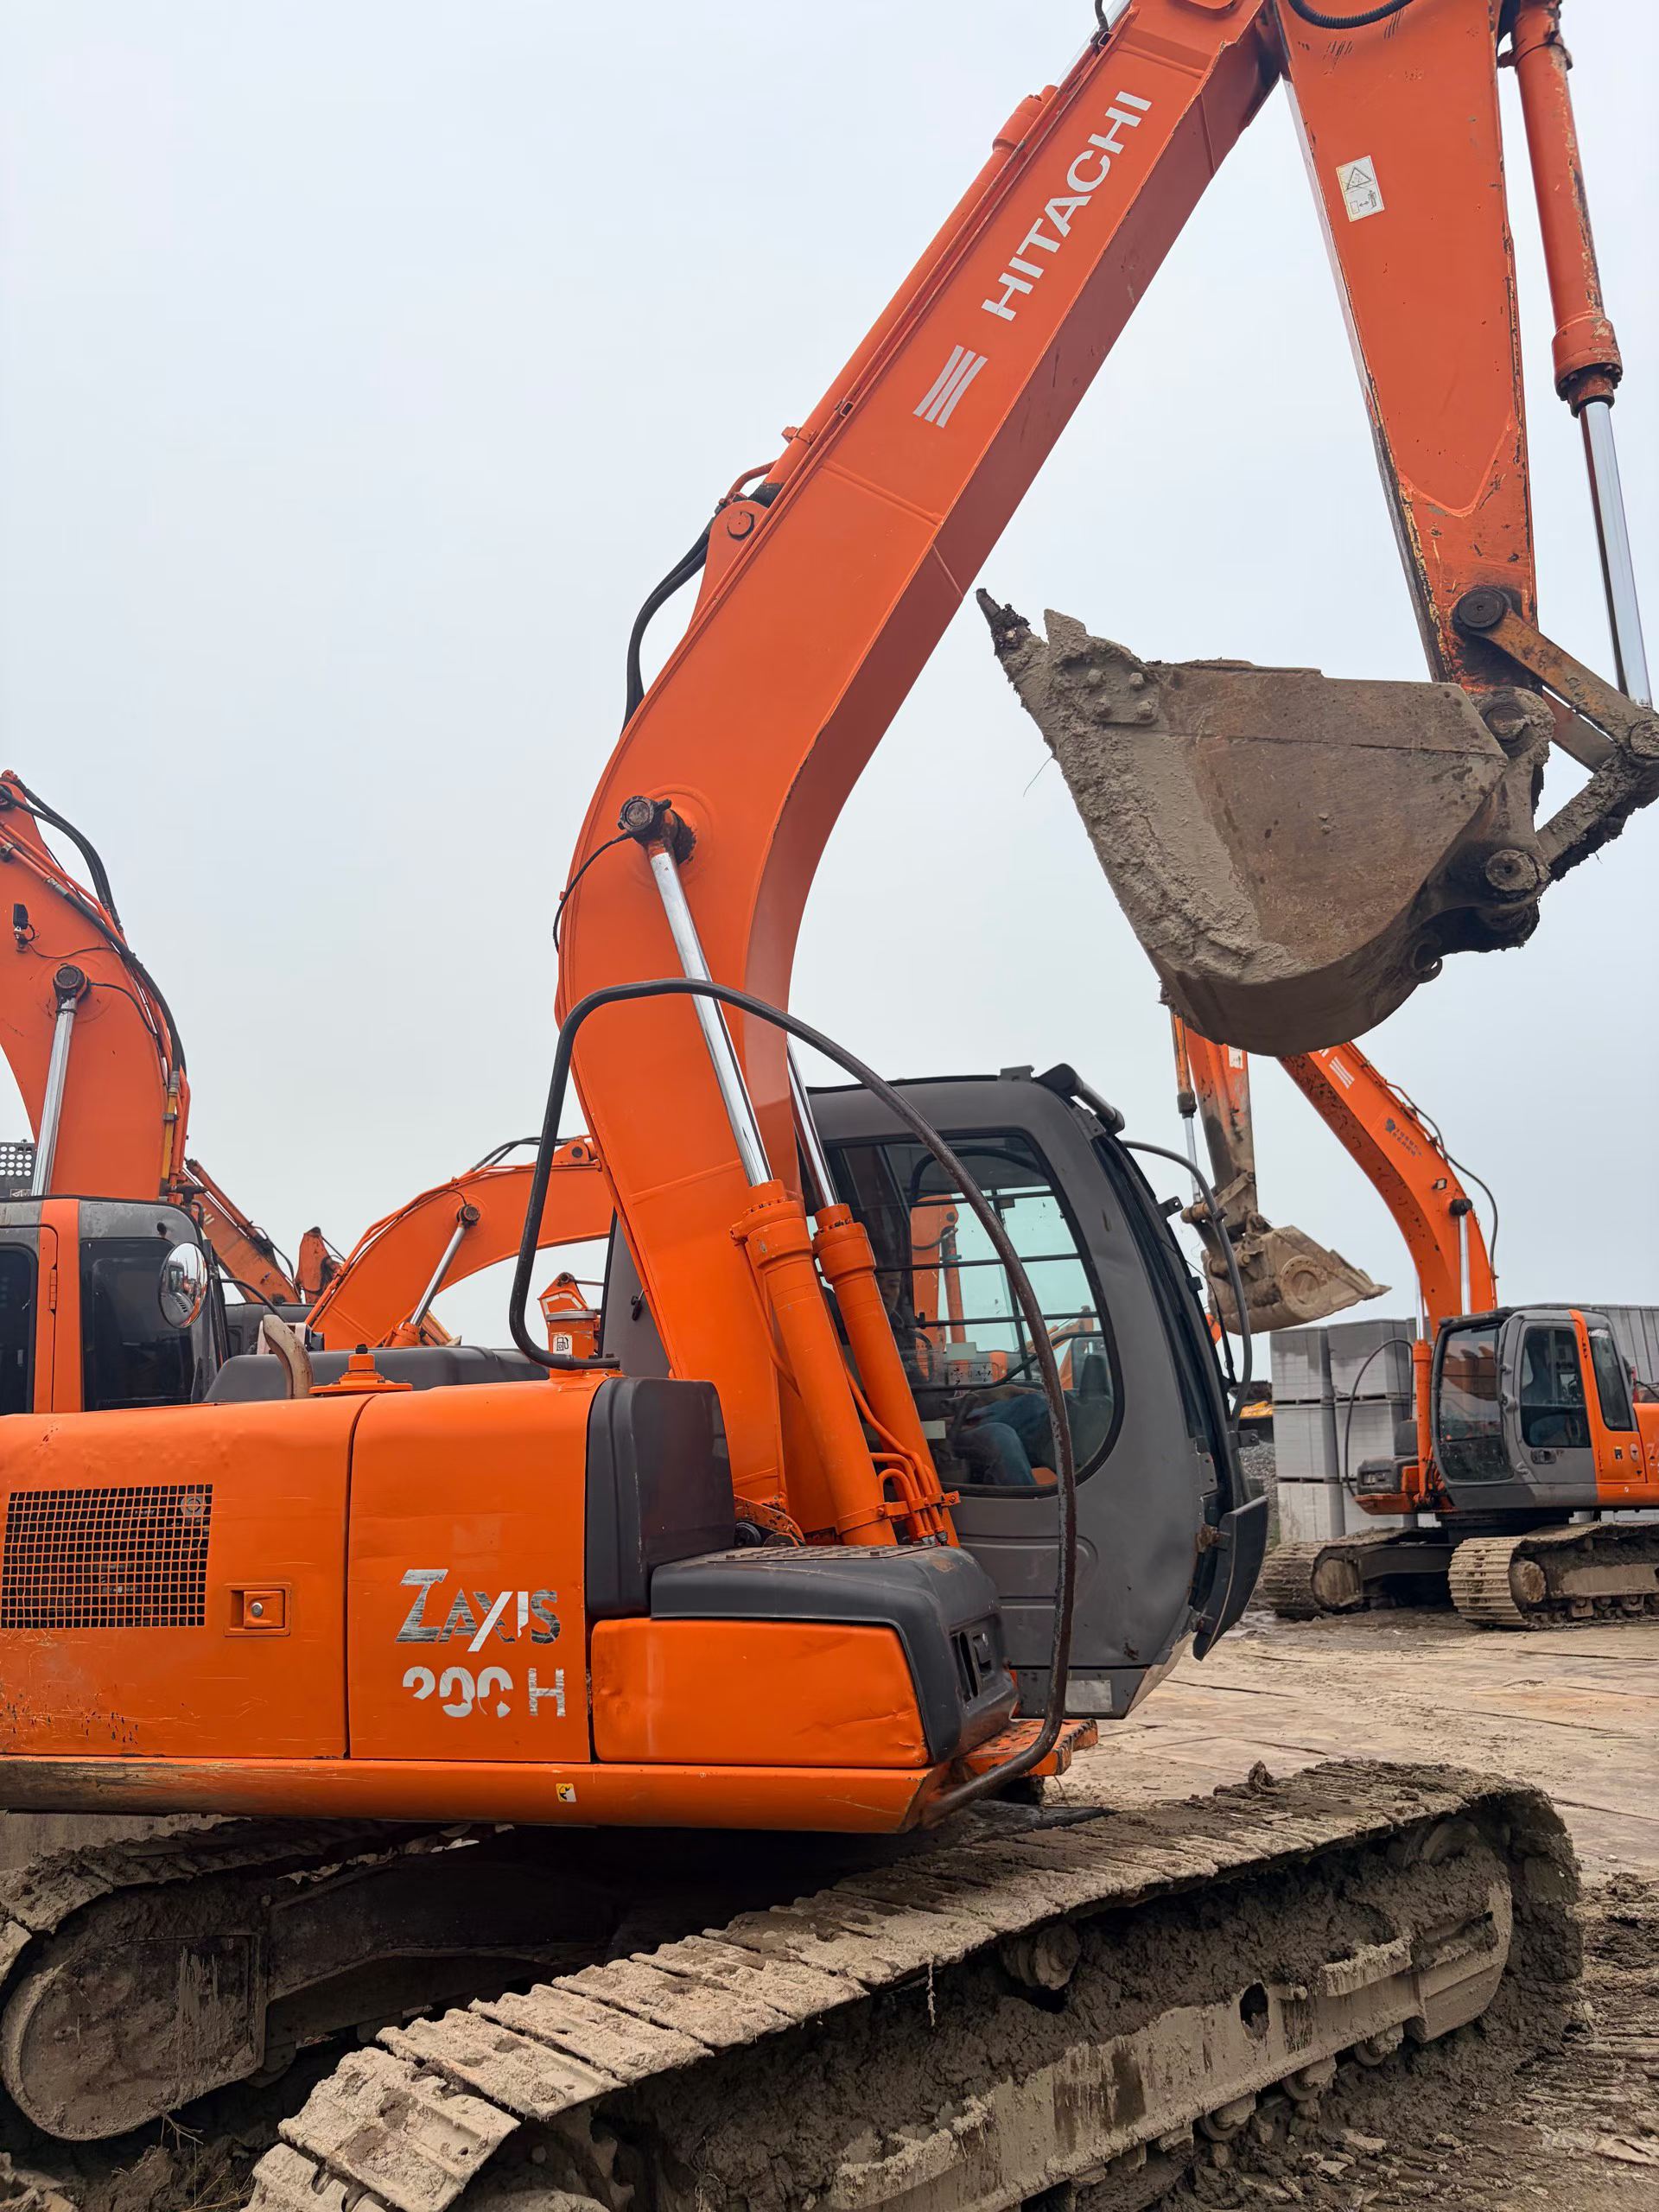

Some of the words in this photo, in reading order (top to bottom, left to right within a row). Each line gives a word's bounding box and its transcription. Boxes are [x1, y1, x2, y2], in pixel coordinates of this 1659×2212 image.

[982, 91, 1152, 321] HITACHI
[395, 1569, 561, 1652] ZAXIS
[528, 1668, 566, 1717] H
